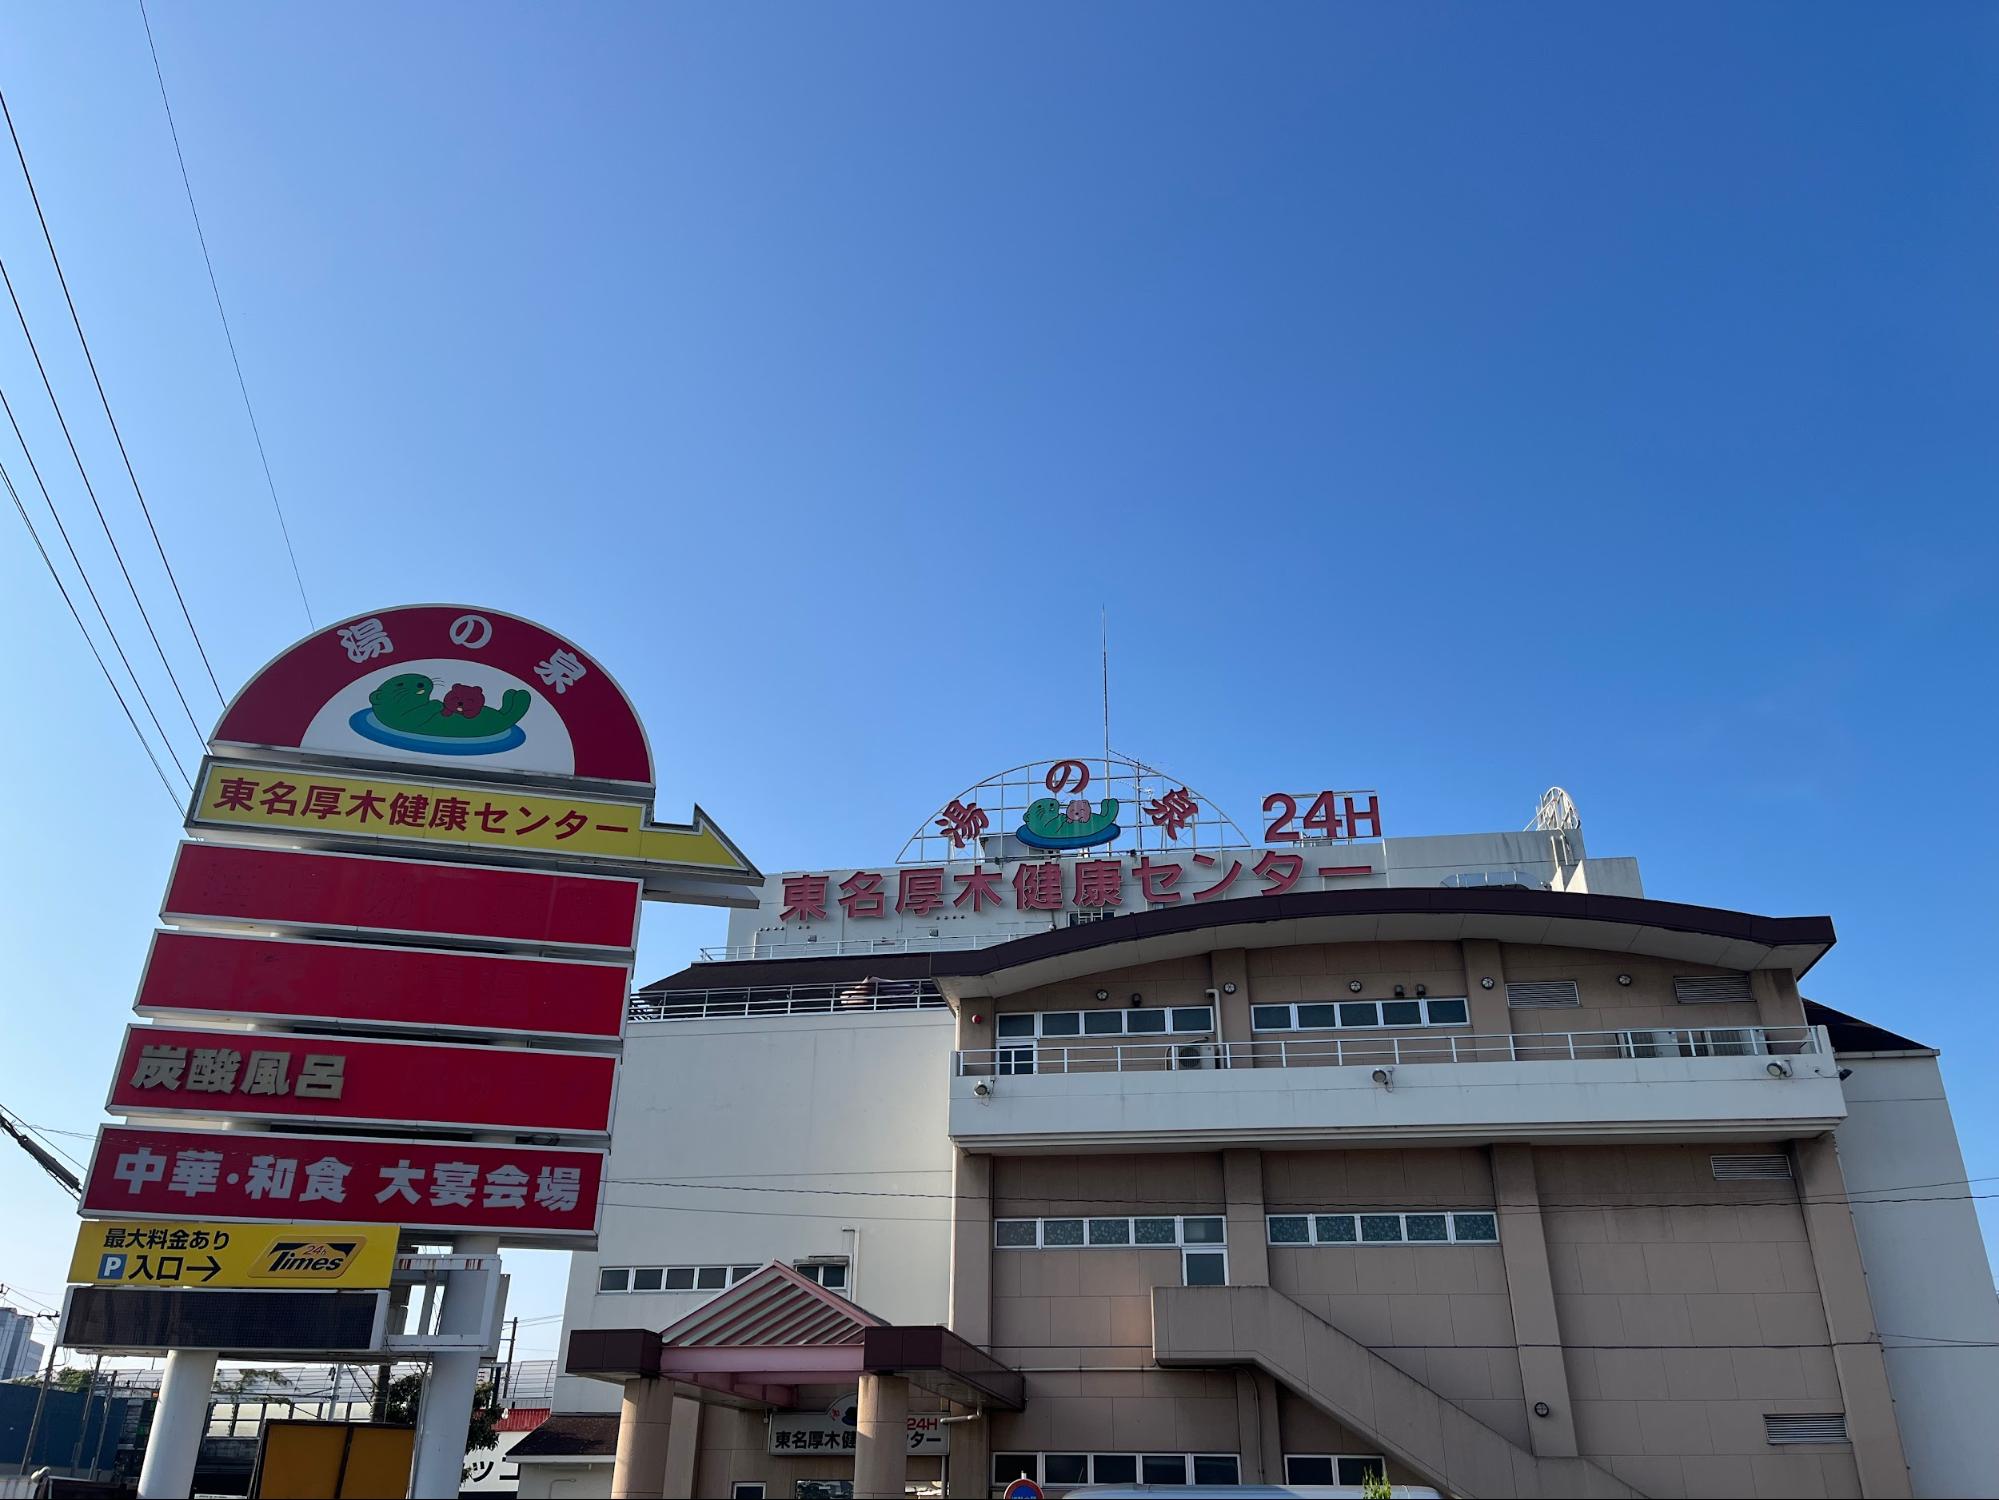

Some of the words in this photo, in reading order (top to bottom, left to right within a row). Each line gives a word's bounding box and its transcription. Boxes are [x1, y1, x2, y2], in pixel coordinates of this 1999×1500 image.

[337, 614, 587, 694] 湯の泉
[213, 777, 629, 840] 東名厚木健康センター
[935, 760, 1199, 848] 湯の泉
[1263, 790, 1381, 843] 24H
[780, 853, 1373, 922] 東名厚木健康センター
[130, 1045, 346, 1099] 炭酸風呂
[113, 1147, 352, 1203] 中華・和食
[375, 1160, 582, 1211] 大宴会場
[104, 1228, 230, 1250] 最大料金あり
[268, 1251, 344, 1272] Times
[128, 1255, 184, 1280] 入口
[906, 1417, 938, 1431] 24H
